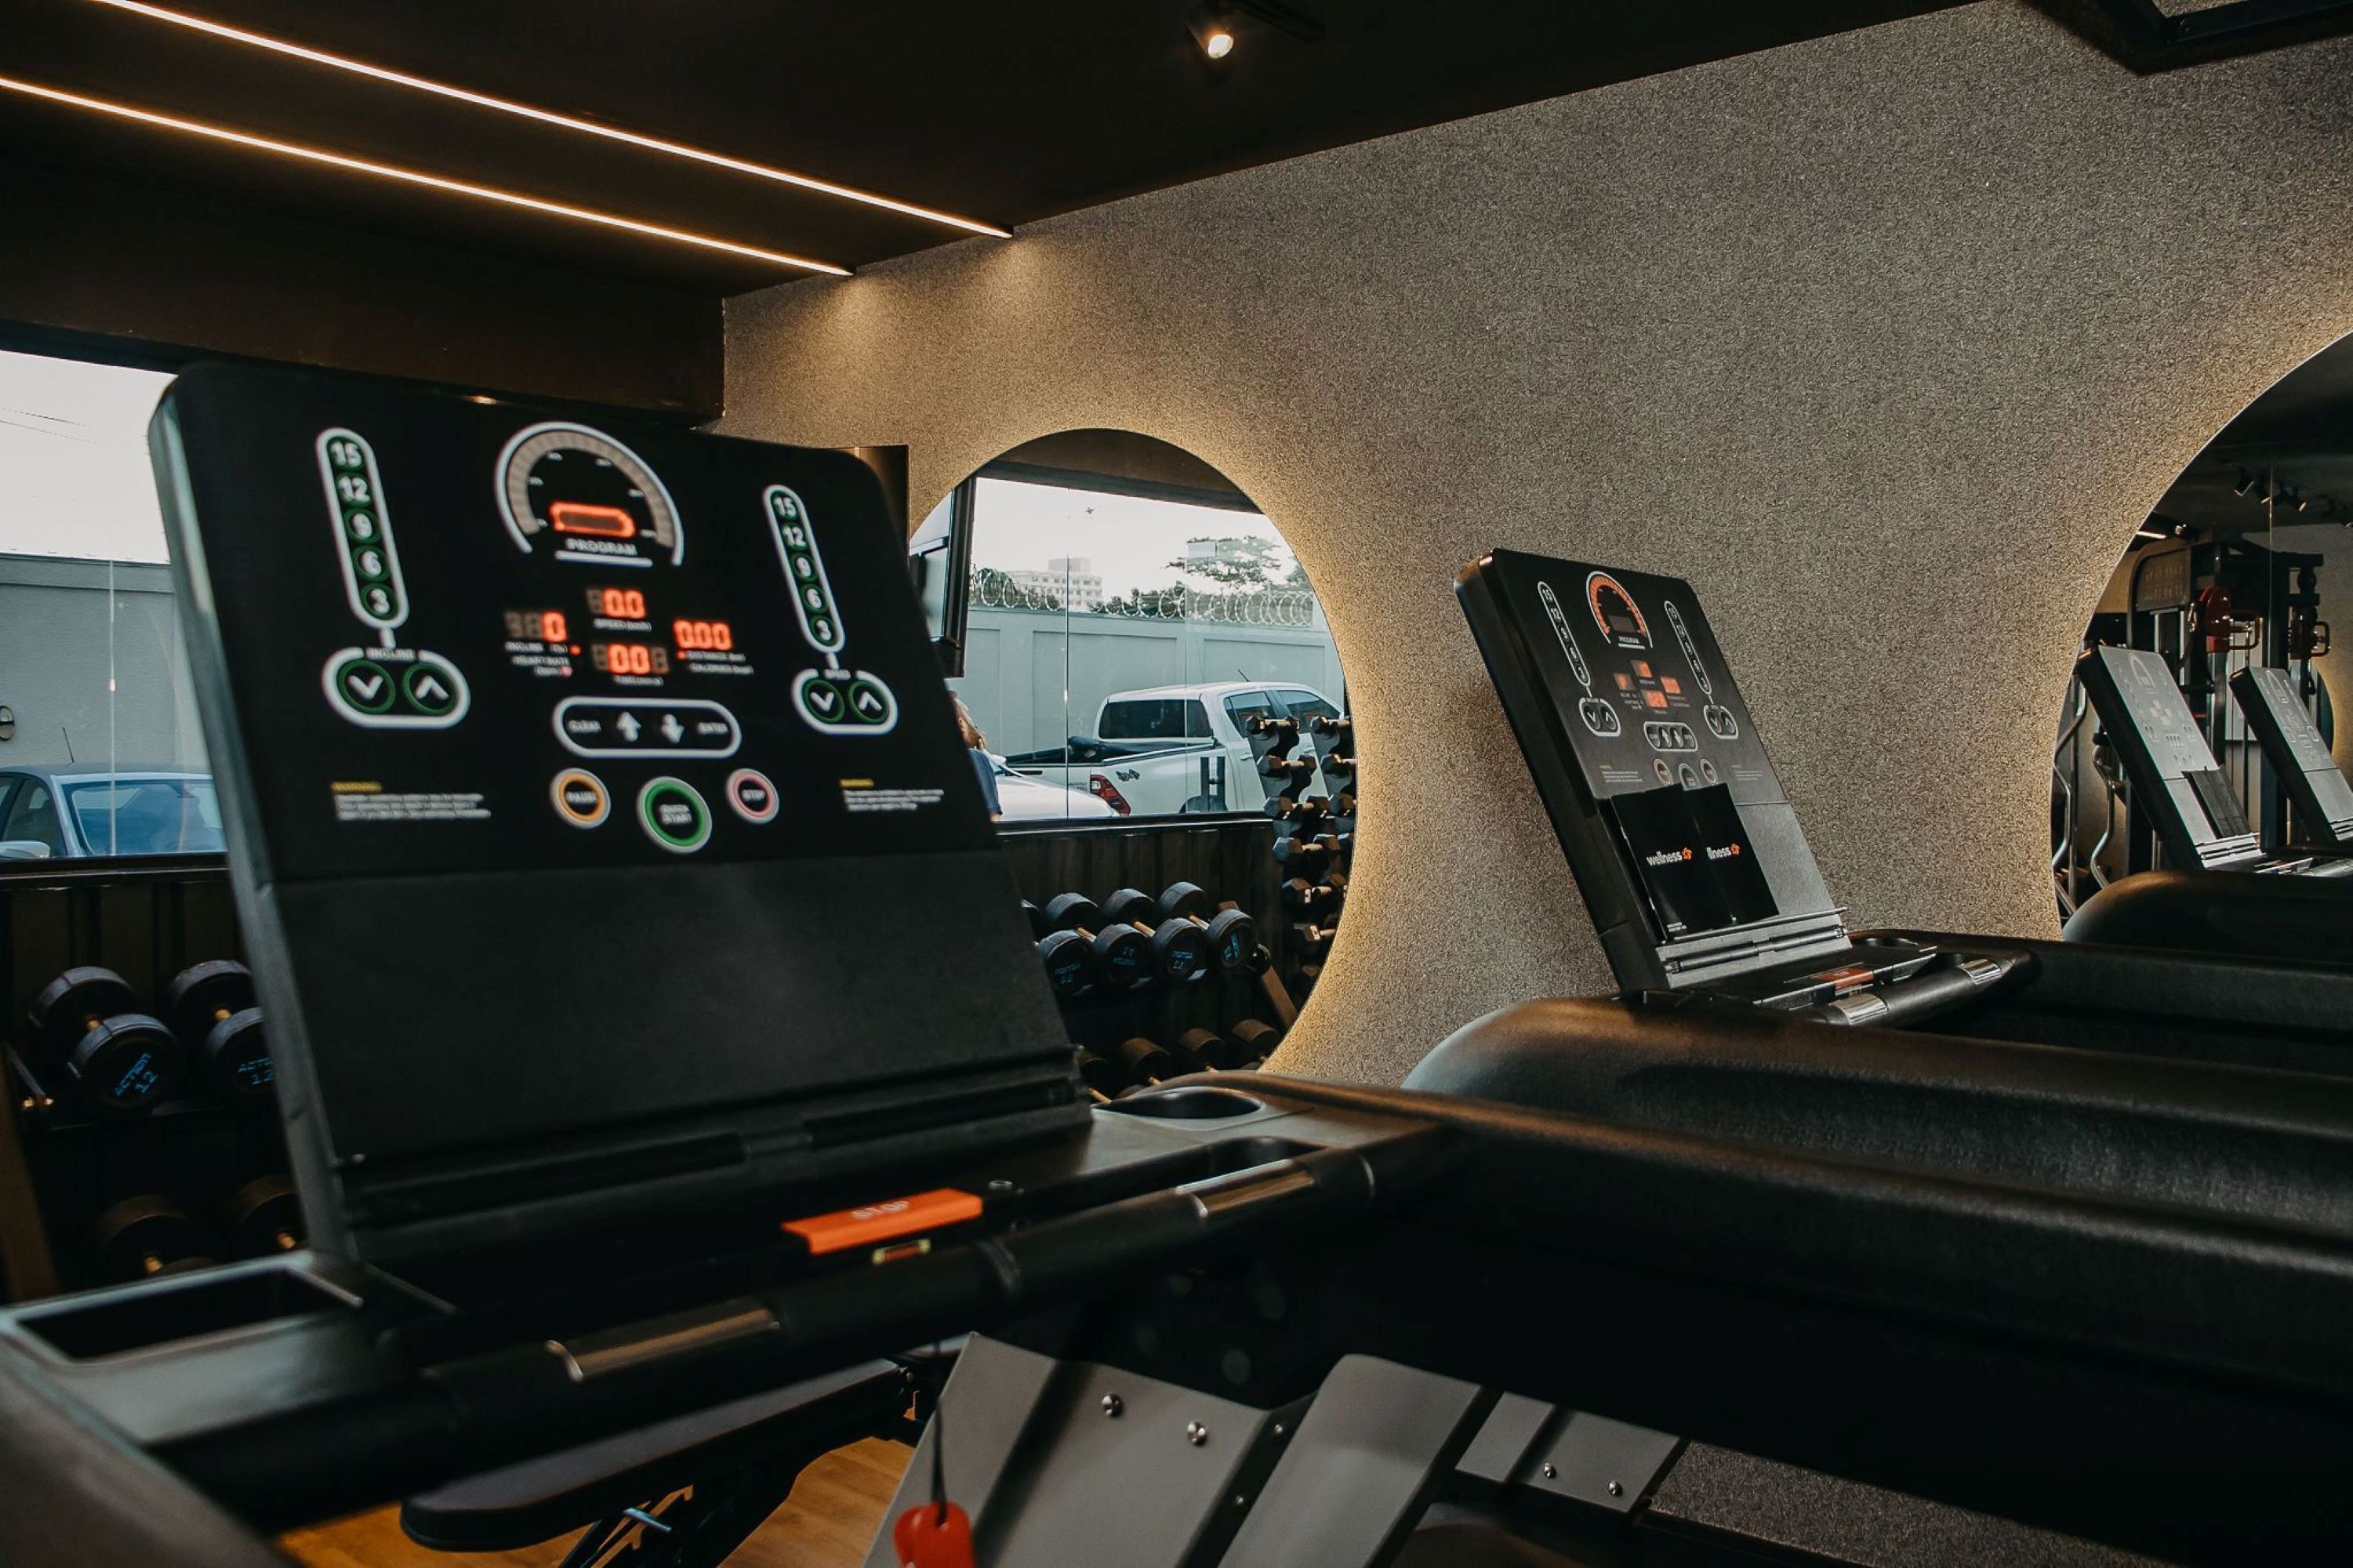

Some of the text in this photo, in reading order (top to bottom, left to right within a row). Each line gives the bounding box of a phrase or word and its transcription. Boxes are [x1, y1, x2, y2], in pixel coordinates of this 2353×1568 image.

[331, 441, 362, 467] 15
[339, 476, 371, 503] 12
[773, 496, 797, 517] 15
[353, 514, 373, 539] 9
[783, 526, 806, 547] 12
[361, 550, 382, 577] 6
[370, 588, 390, 614] 3
[806, 588, 822, 608] 6
[541, 611, 568, 643] 0
[1550, 608, 1561, 621] 12
[816, 619, 832, 641] 3
[114, 1052, 152, 1097] ACTION
[135, 1070, 158, 1093] 12
